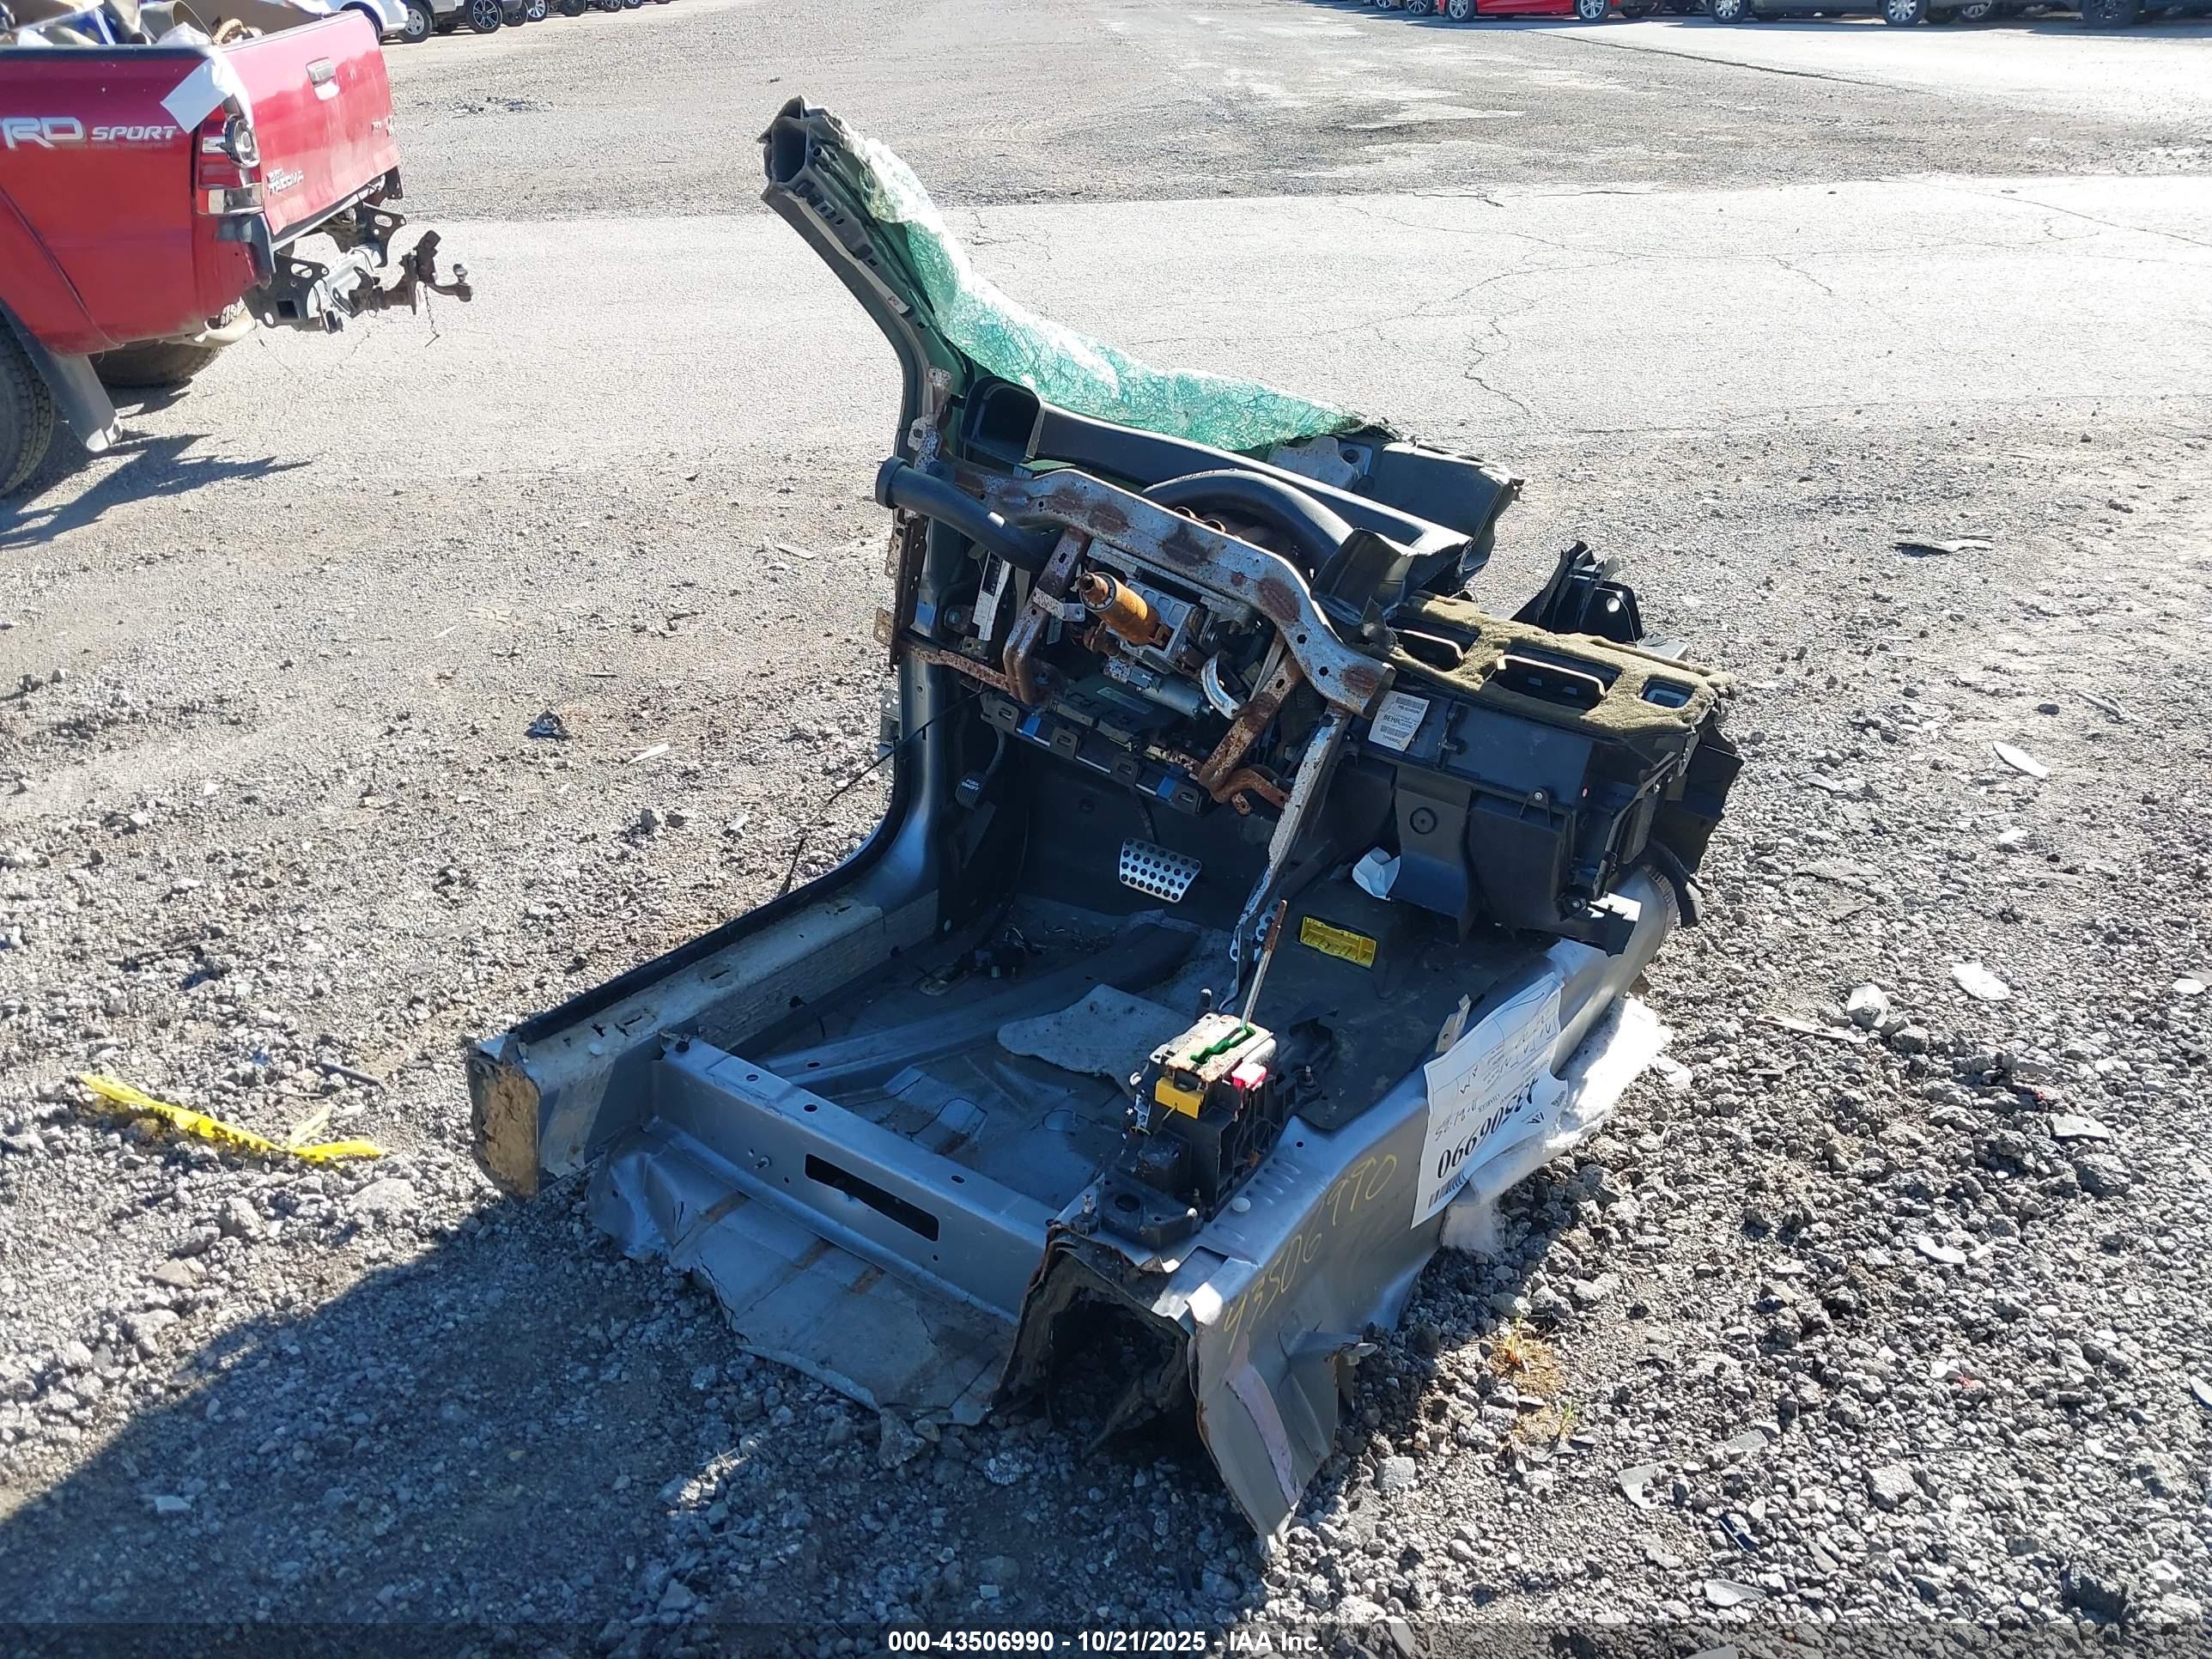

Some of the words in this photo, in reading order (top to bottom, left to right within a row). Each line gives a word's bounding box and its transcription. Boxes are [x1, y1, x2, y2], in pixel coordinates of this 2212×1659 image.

[0, 117, 83, 149] RD
[90, 125, 177, 140] SPORT
[1437, 1076, 1540, 1180] 43506990
